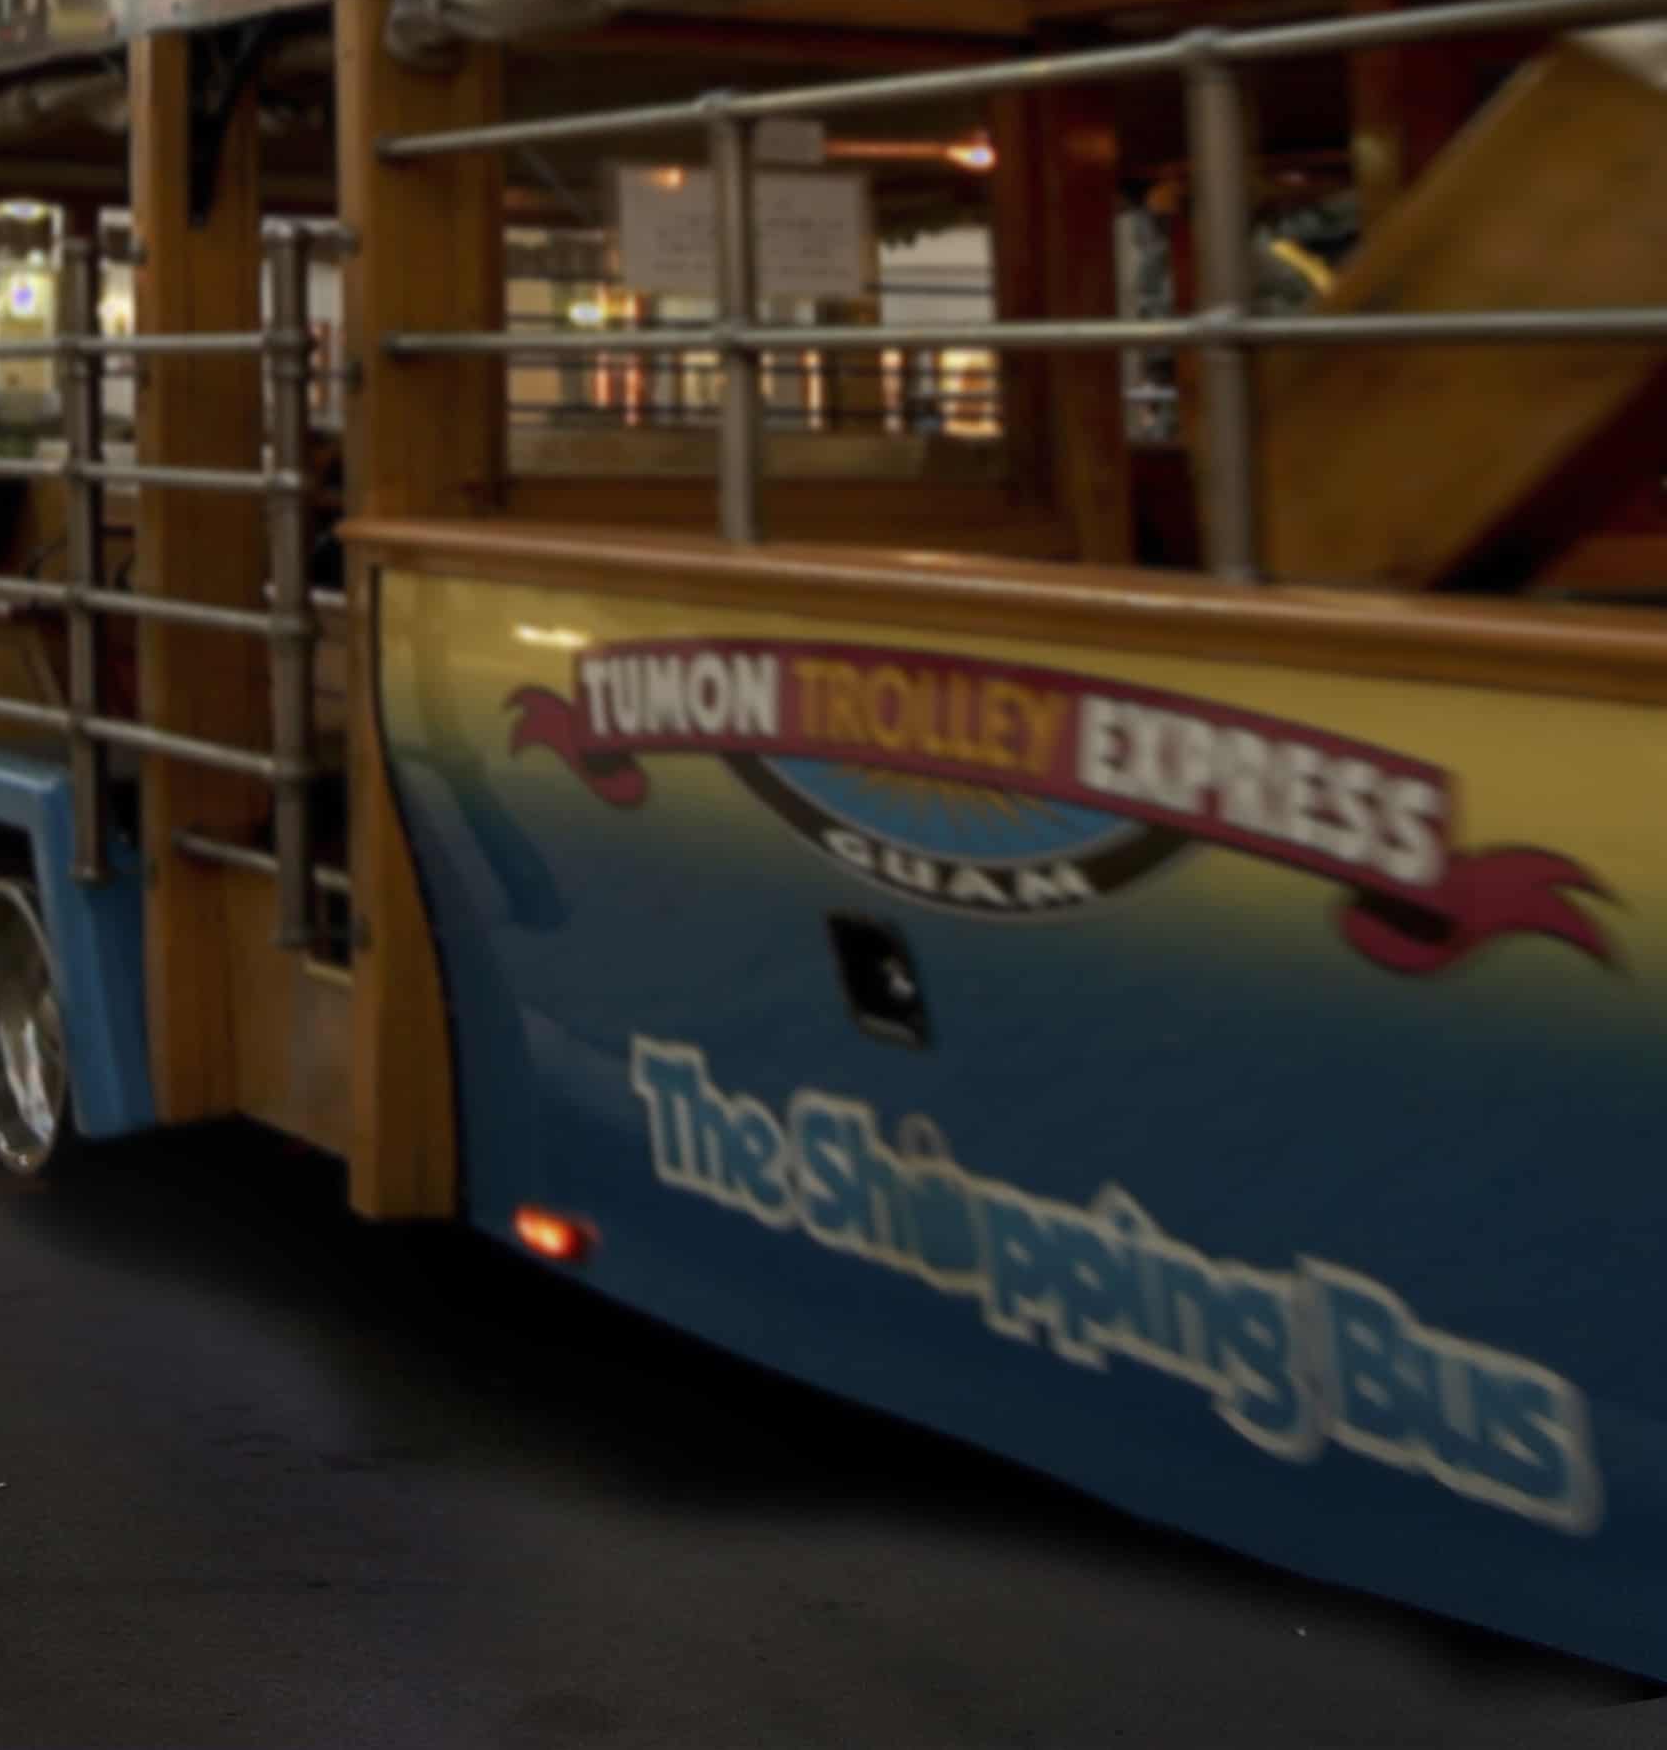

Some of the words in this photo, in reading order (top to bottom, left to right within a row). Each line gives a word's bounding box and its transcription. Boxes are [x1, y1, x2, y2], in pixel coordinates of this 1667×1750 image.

[581, 655, 778, 737] TUMON
[792, 658, 1066, 777] TROLLEY
[1077, 693, 1447, 888] EXPRESS
[819, 827, 1095, 909] GUAM
[629, 1034, 794, 1230] The
[1292, 1253, 1604, 1538] Bus
